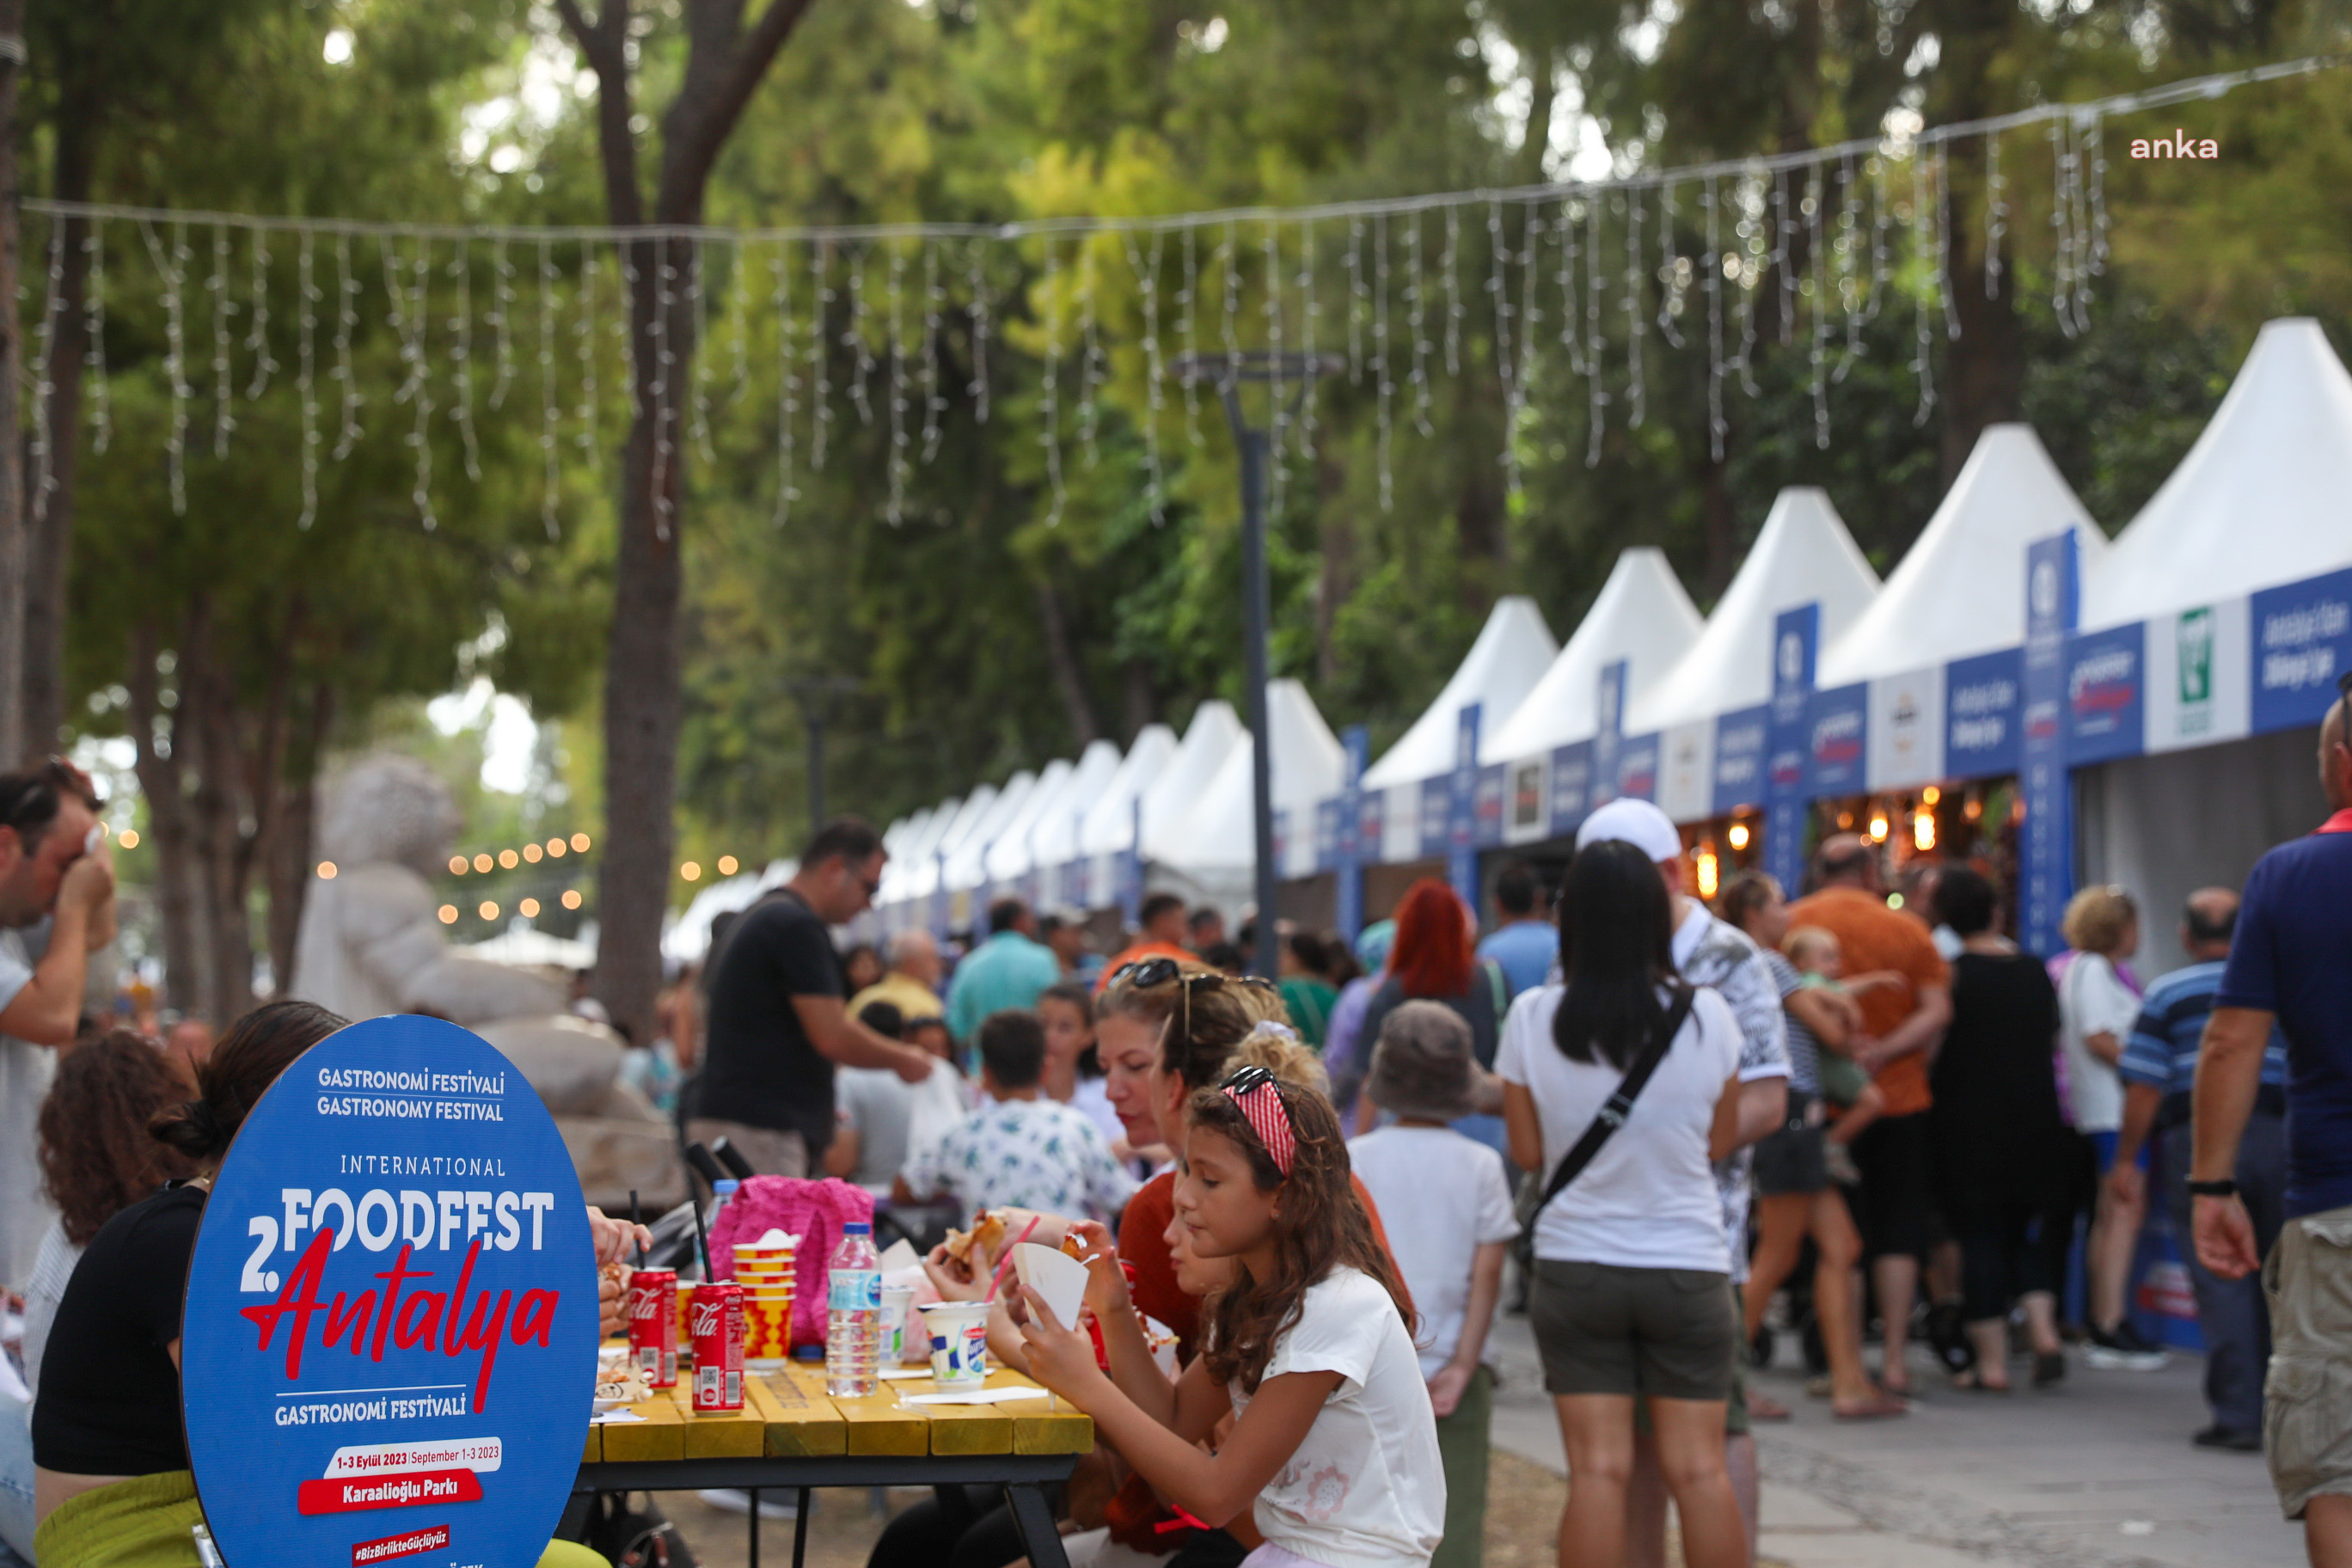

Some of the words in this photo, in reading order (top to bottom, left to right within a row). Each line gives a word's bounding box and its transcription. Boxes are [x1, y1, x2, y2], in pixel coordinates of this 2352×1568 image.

[318, 1067, 429, 1091] GASTRONOMİ
[432, 1069, 505, 1094] FESTİVALİ
[317, 1096, 432, 1119] GASTRONOMY
[435, 1101, 504, 1122] FESTIVAL
[340, 1155, 505, 1177] INTERNATIONAL
[240, 1216, 279, 1292] 2.
[282, 1187, 554, 1253] FOODFEST
[239, 1227, 560, 1414] Antalya
[275, 1397, 387, 1426] GASTRONOMİ
[390, 1392, 467, 1419] FESTİVALİ
[337, 1455, 354, 1469] 1-3
[356, 1454, 381, 1470] Eylül
[383, 1452, 407, 1467] 2023
[411, 1450, 459, 1467] September
[462, 1448, 476, 1461] 1-3
[478, 1446, 499, 1460] 2023
[343, 1480, 421, 1504] Karaalioğlu
[423, 1477, 458, 1497] Parkı
[355, 1531, 446, 1562] #BizBirlikteGüçlüyüz
